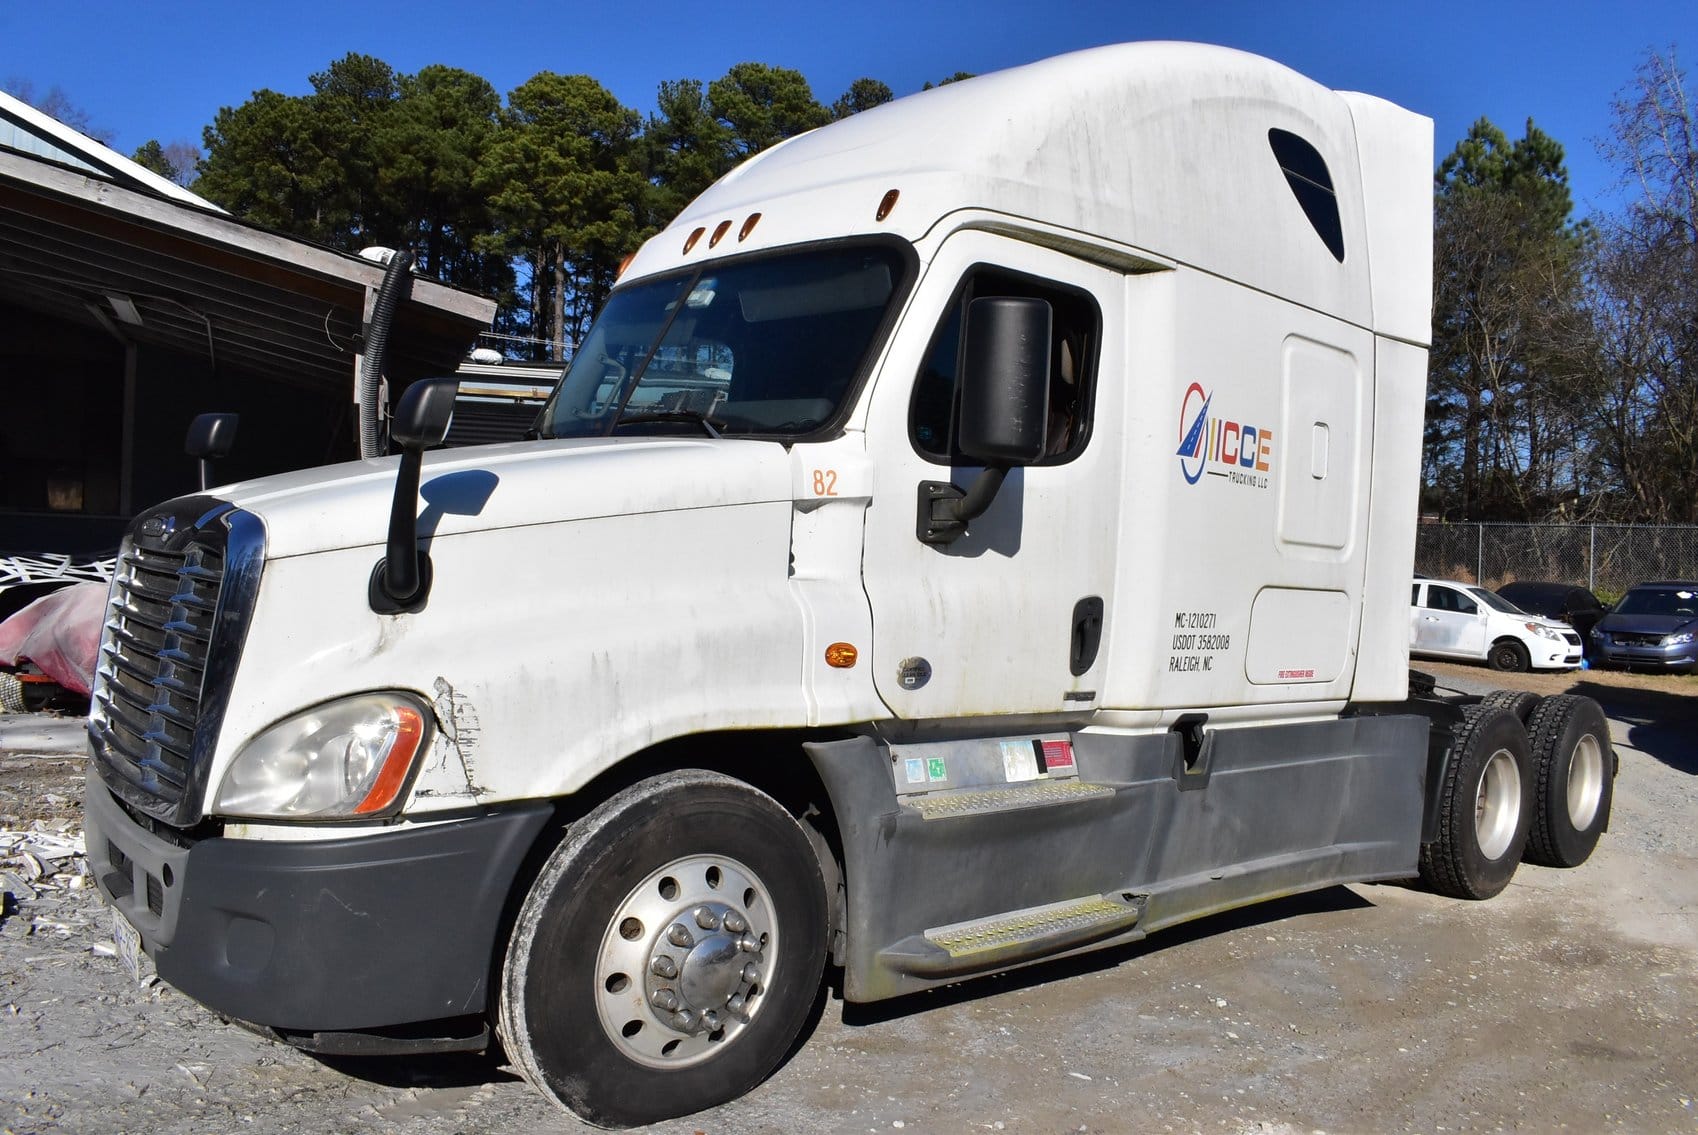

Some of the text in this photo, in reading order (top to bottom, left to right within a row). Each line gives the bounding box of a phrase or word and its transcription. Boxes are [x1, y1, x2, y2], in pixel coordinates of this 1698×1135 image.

[812, 469, 838, 496] 82
[1228, 471, 1268, 489] TRUCKING LLC
[1175, 612, 1217, 629] MC-1210271
[1172, 635, 1230, 650] USDOT 3582008
[1202, 656, 1213, 671] NC
